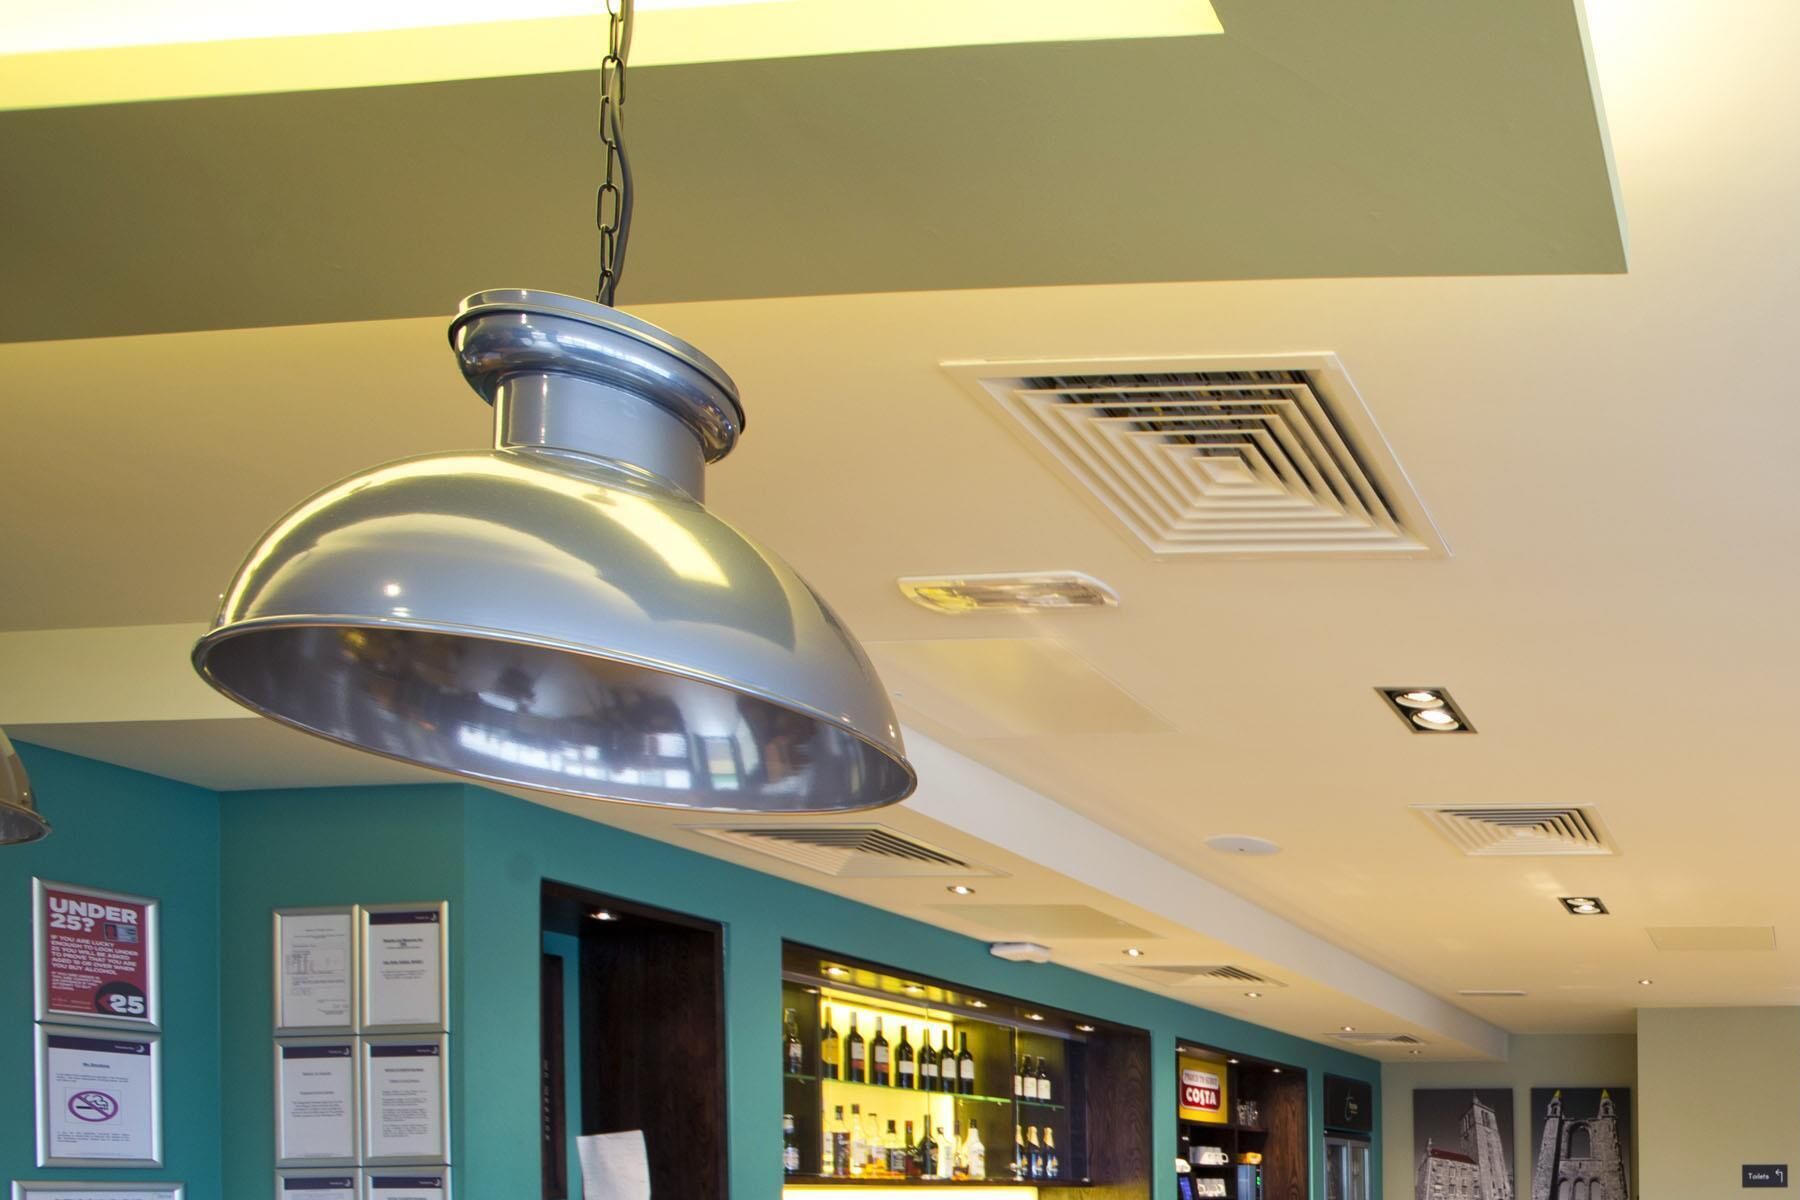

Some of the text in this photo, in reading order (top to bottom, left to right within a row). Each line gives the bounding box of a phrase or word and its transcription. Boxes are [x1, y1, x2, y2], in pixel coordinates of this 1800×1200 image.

[49, 897, 138, 924] UNDER
[49, 912, 95, 932] 25?
[110, 993, 144, 1014] 25
[1186, 1087, 1217, 1106] COSTA
[1748, 1172, 1770, 1180] Toilets
